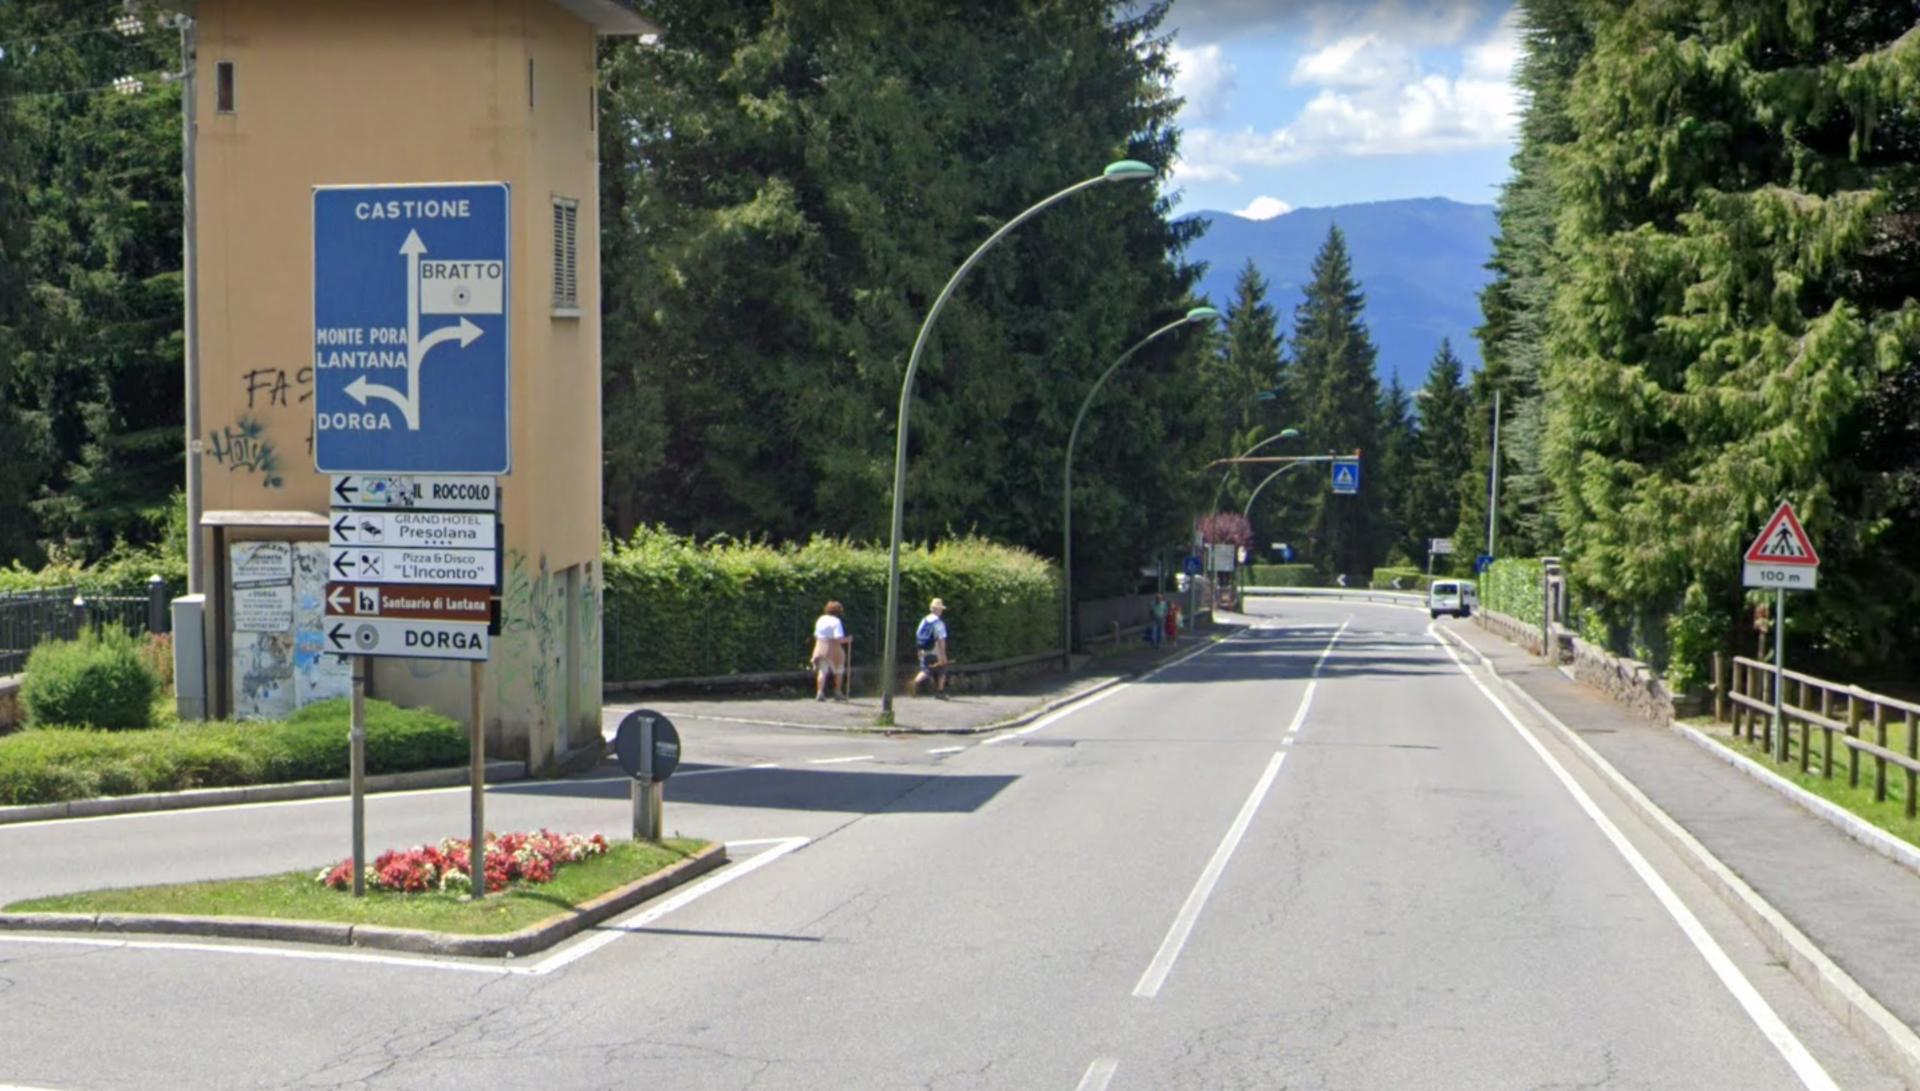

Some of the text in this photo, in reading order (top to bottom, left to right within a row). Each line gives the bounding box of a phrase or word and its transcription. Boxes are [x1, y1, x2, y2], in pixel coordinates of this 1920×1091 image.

[355, 200, 471, 220] CASTIONE
[421, 263, 501, 279] BRATTO
[317, 327, 407, 345] MONTE PORA
[317, 352, 407, 369] LANTANA
[318, 413, 391, 430] DORGA
[433, 484, 490, 500] ROCCOLO
[395, 514, 481, 525] GRAND HOTEL
[400, 525, 477, 539] Presolana
[403, 553, 431, 563] Pizza
[444, 554, 475, 564] Disco
[1760, 571, 1785, 581] 100
[382, 596, 486, 610] Santuario di Lantana
[405, 630, 482, 650] DORGA
